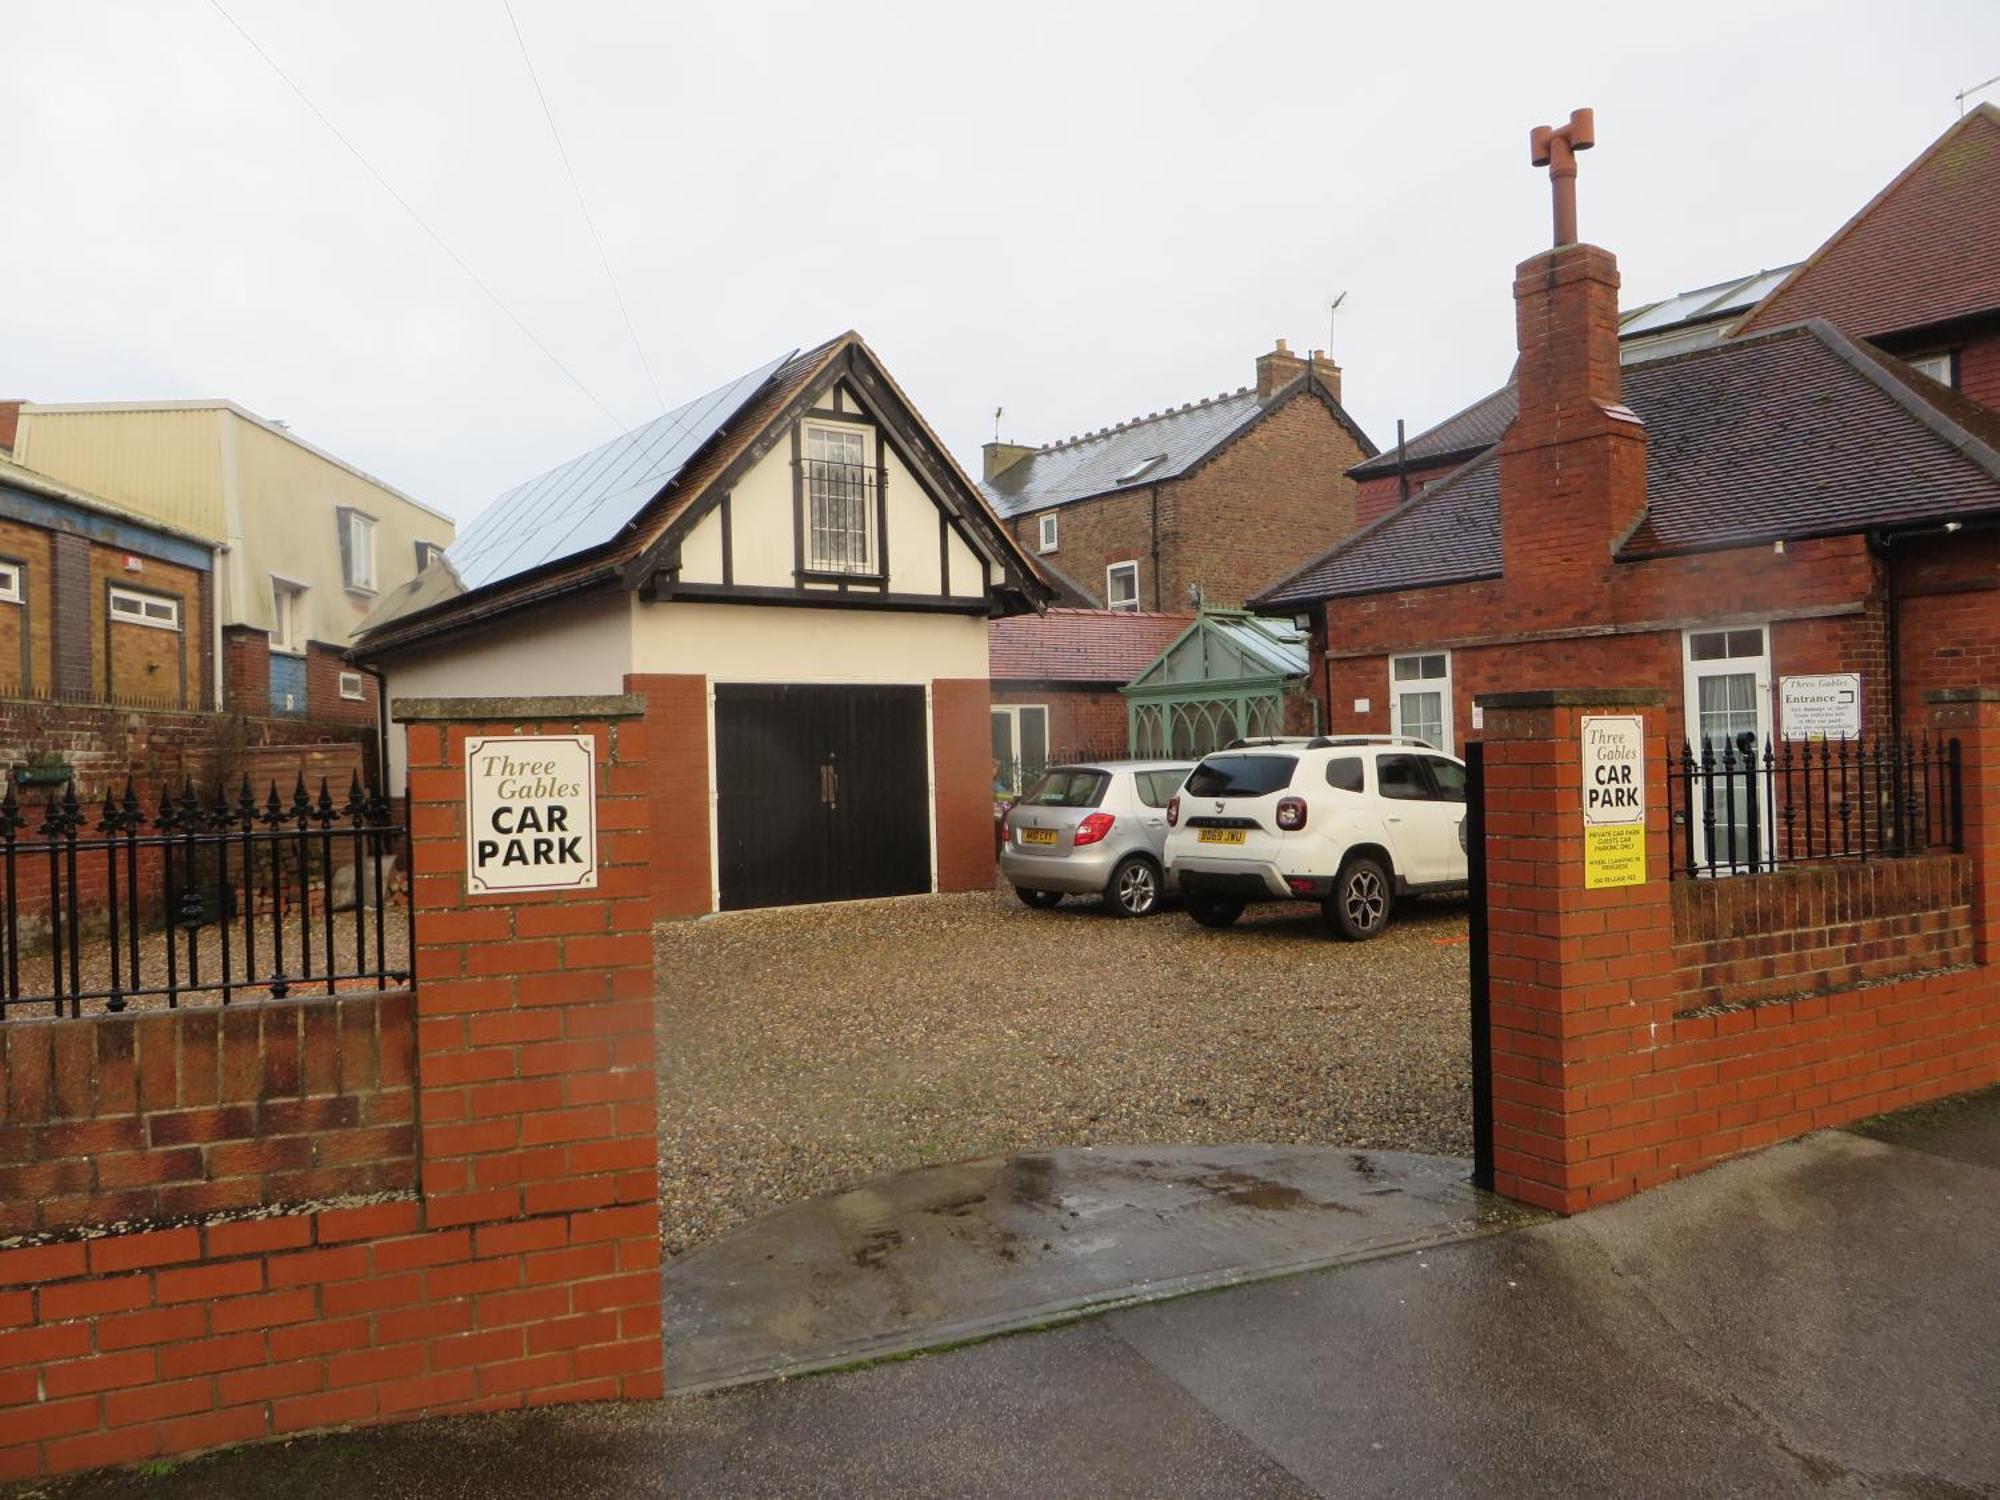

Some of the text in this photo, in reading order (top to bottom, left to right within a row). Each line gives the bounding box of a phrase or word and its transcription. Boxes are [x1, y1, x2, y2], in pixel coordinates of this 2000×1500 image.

[1785, 694, 1836, 703] Entrance
[1590, 728, 1626, 745] Three
[1597, 745, 1638, 761] Gables
[482, 755, 556, 777] Three
[1595, 765, 1632, 785] CAR
[497, 777, 581, 799] Gables
[1589, 787, 1640, 808] PARK
[491, 805, 569, 834] CAR
[478, 836, 584, 867] PARK
